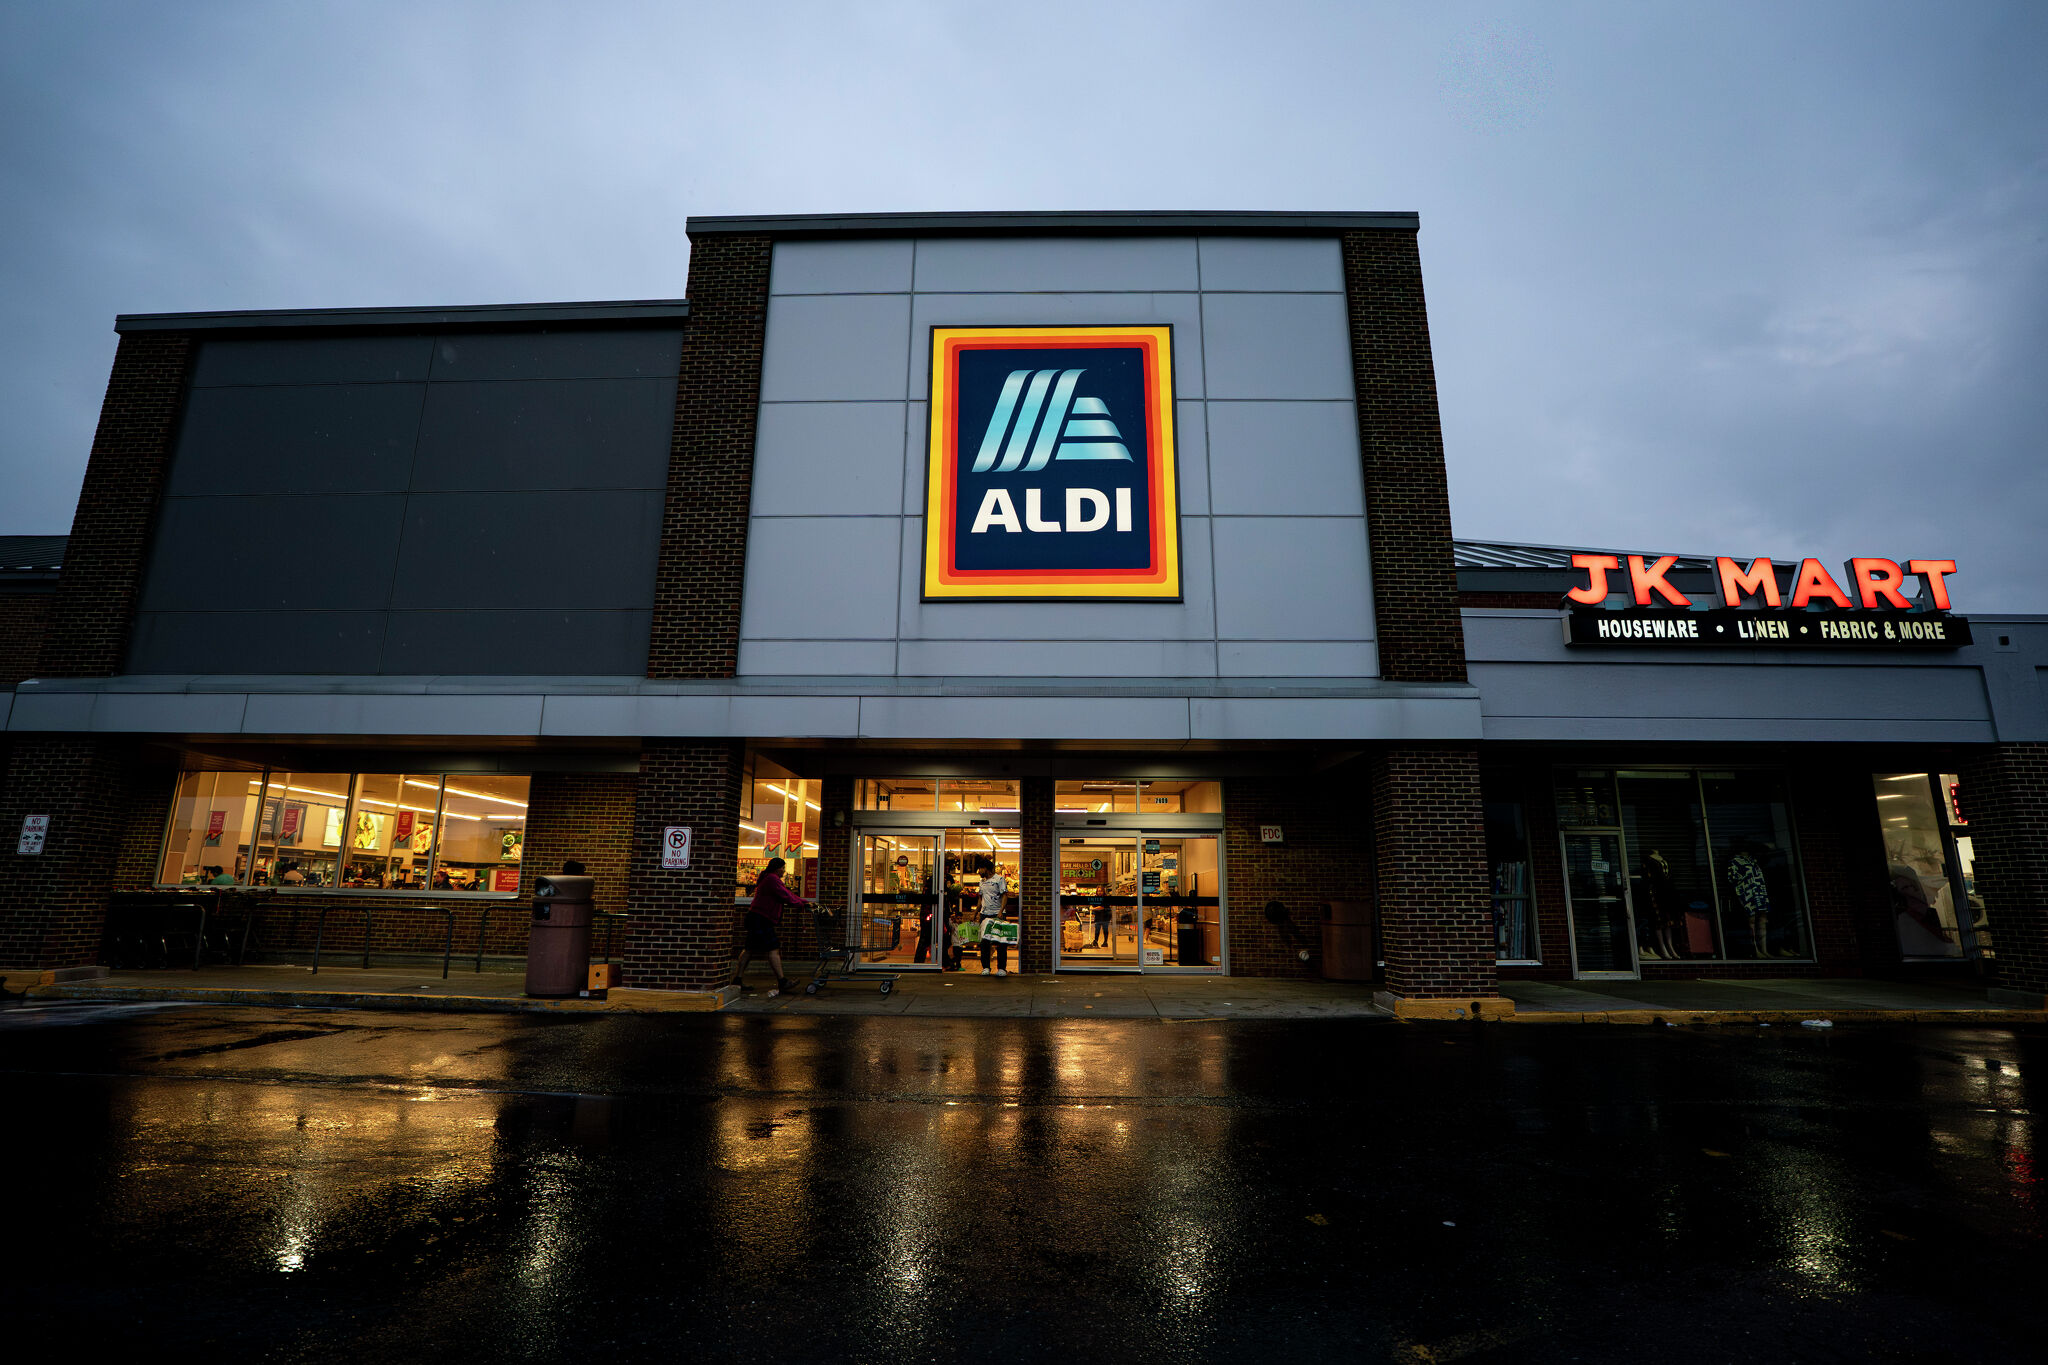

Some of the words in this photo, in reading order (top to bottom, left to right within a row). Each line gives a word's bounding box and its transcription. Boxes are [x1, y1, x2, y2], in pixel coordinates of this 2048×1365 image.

[971, 487, 1132, 533] ALDI
[1566, 554, 1692, 607] JK
[1716, 556, 1957, 609] MART
[1597, 619, 1699, 639] HOUSEWARE
[1737, 620, 1790, 640] LINEN
[1819, 620, 1879, 639] FABRIC
[1883, 621, 1896, 640] &
[1898, 621, 1946, 640] MORE
[32, 817, 41, 825] NO
[1263, 828, 1280, 840] FDC
[665, 857, 686, 866] PARKING
[1063, 869, 1096, 878] FRSH
